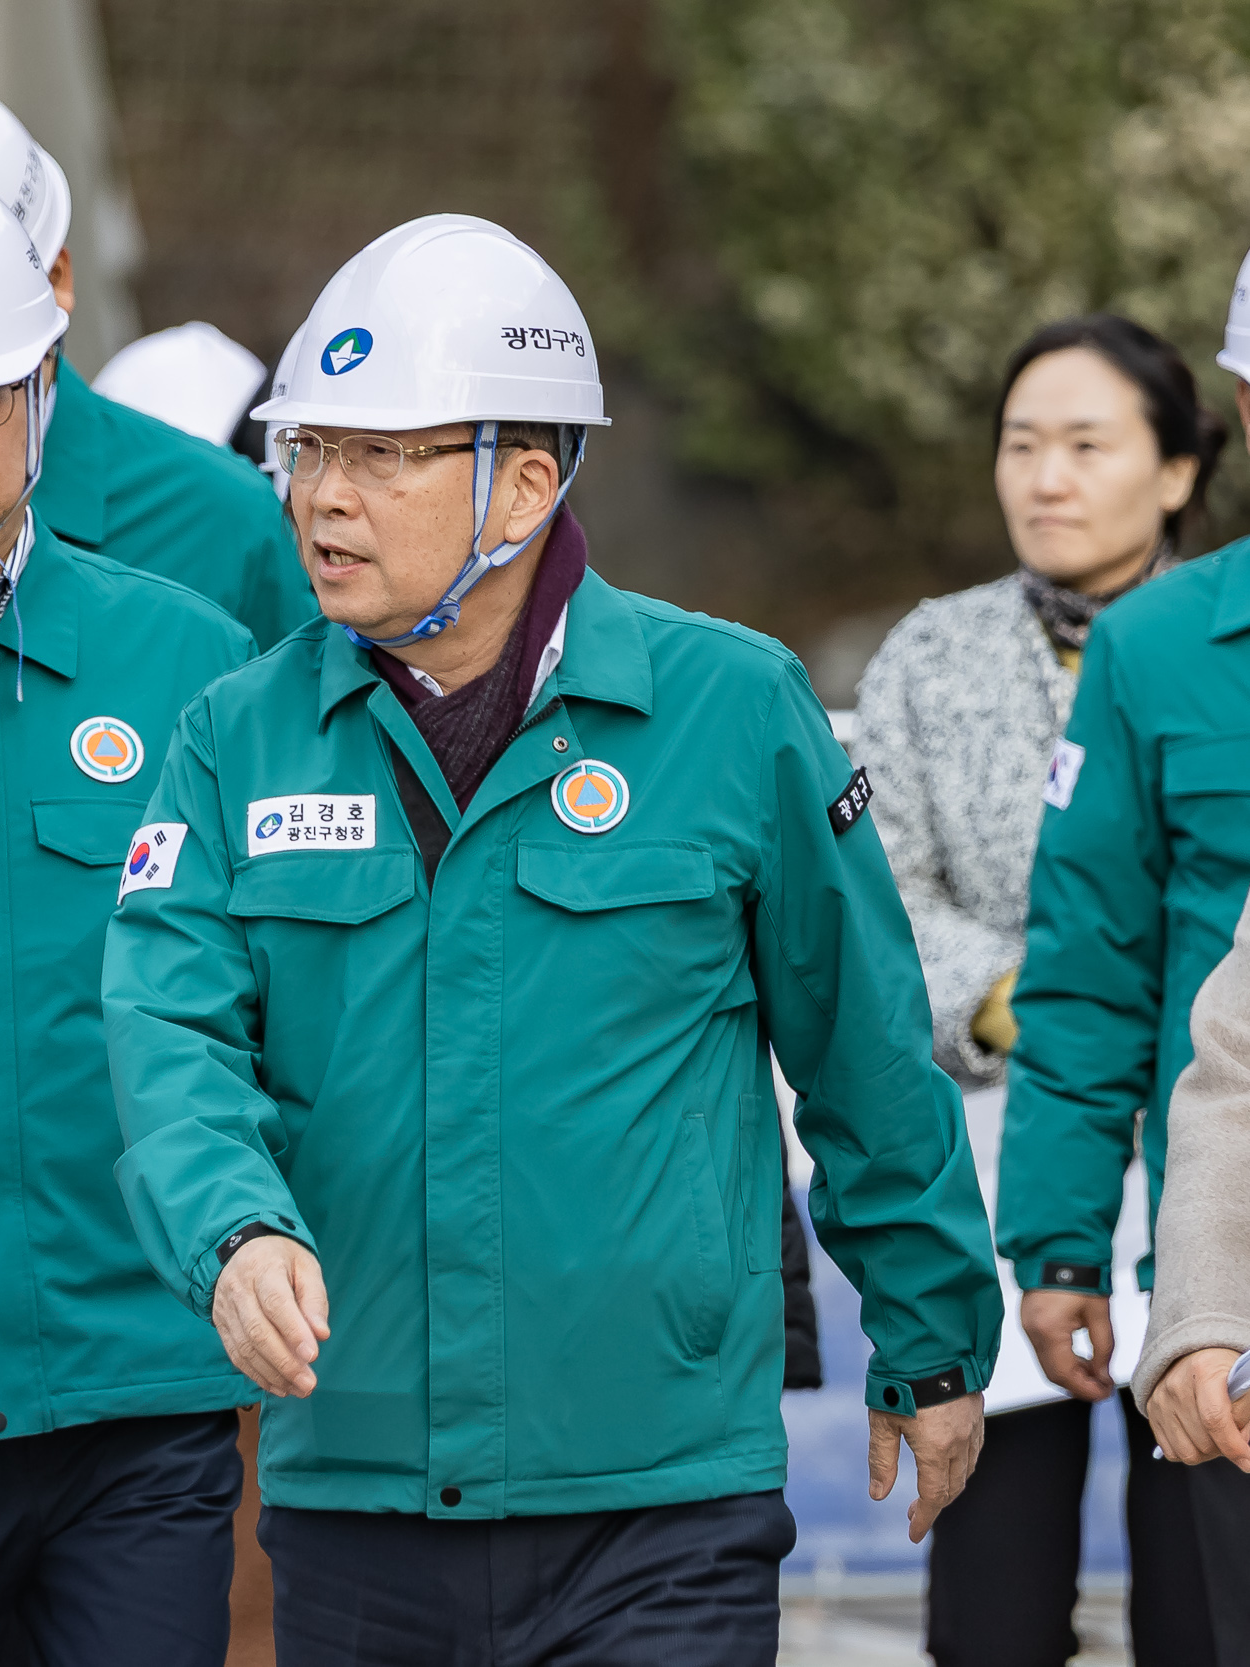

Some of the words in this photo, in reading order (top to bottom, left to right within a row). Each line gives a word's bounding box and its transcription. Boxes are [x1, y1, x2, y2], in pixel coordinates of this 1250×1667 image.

[500, 326, 586, 358] 광진구청
[837, 775, 870, 822] 광진구
[286, 825, 366, 842] 광진구청장
